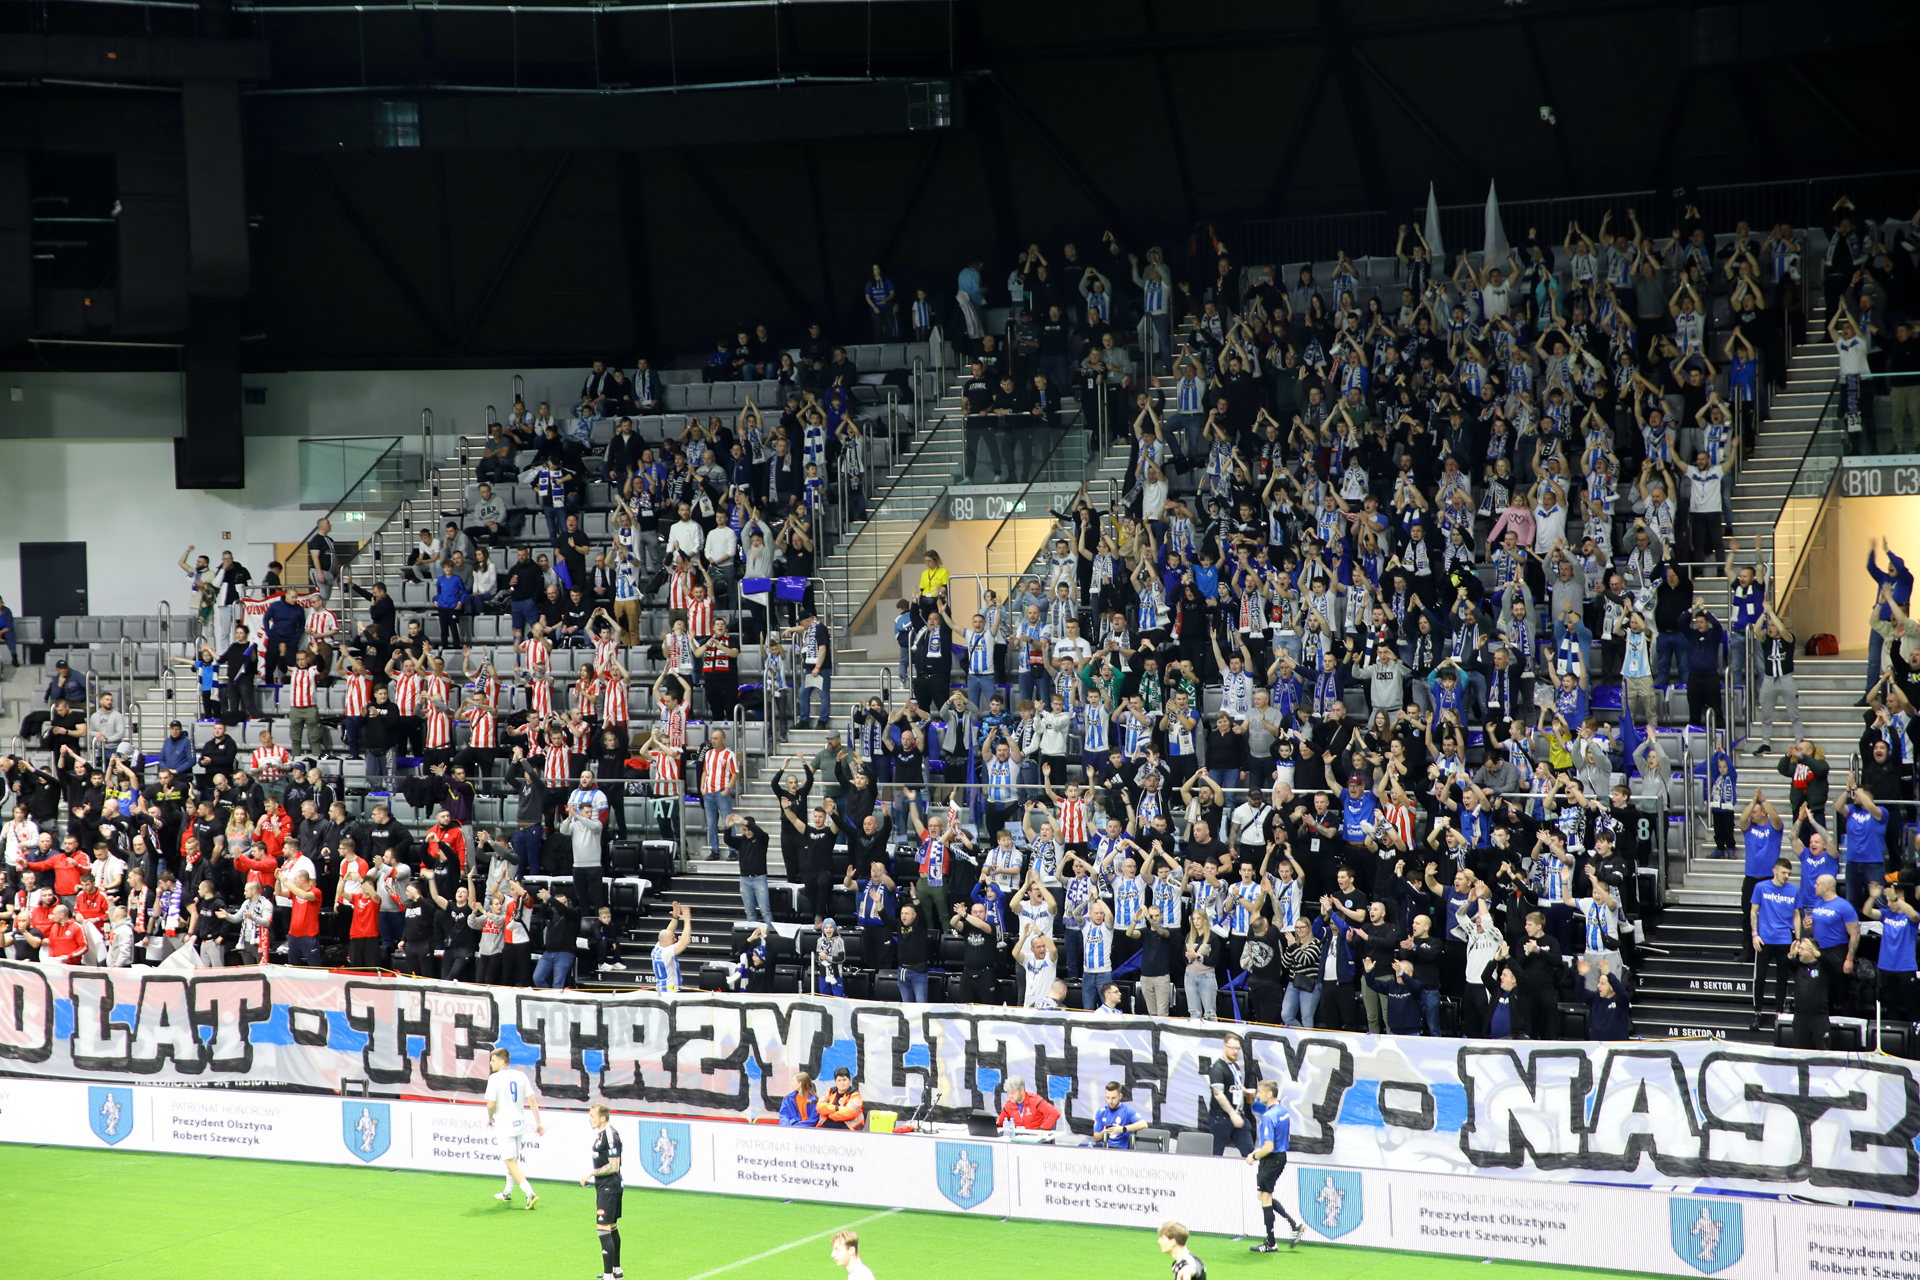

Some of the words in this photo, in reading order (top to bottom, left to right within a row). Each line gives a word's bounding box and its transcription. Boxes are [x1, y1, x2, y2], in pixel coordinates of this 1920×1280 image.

[1849, 469, 1881, 496] B10
[1894, 467, 1919, 495] C3
[955, 497, 974, 520] B9
[986, 496, 1005, 519] C2
[654, 800, 674, 818] A7
[1690, 980, 1699, 989] A8
[1703, 981, 1733, 991] SEKTOR
[1736, 983, 1746, 991] A9
[69, 971, 271, 1075] LAT
[345, 981, 499, 1093] TE
[1669, 1027, 1678, 1036] A8
[1716, 1030, 1726, 1039] A9
[509, 1080, 518, 1103] 9
[172, 1116, 224, 1128] Prezydent
[227, 1119, 273, 1132] Olsztyna
[173, 1130, 207, 1141] Robert
[210, 1133, 260, 1146] Szewczyk
[433, 1132, 488, 1145] Prezydent
[491, 1137, 540, 1149] Oyna
[433, 1147, 471, 1159] Robert
[473, 1151, 526, 1163] Szewk
[737, 1154, 798, 1168] Prezydent
[800, 1159, 854, 1173] Olsztyna
[737, 1170, 778, 1182] Robert
[781, 1174, 839, 1189] Szewczyk
[1044, 1178, 1112, 1193] Prezydent
[1116, 1183, 1176, 1198] Olsztyna
[1045, 1194, 1090, 1208] Robert
[1094, 1198, 1159, 1214] Szewczyk
[1419, 1207, 1495, 1224] Prezydent
[1499, 1213, 1567, 1231] Olsztyna
[1421, 1224, 1471, 1239] Robert
[1475, 1229, 1548, 1248] Szewczyk
[1808, 1241, 1895, 1260] Prezydent
[1809, 1259, 1868, 1276] Robert
